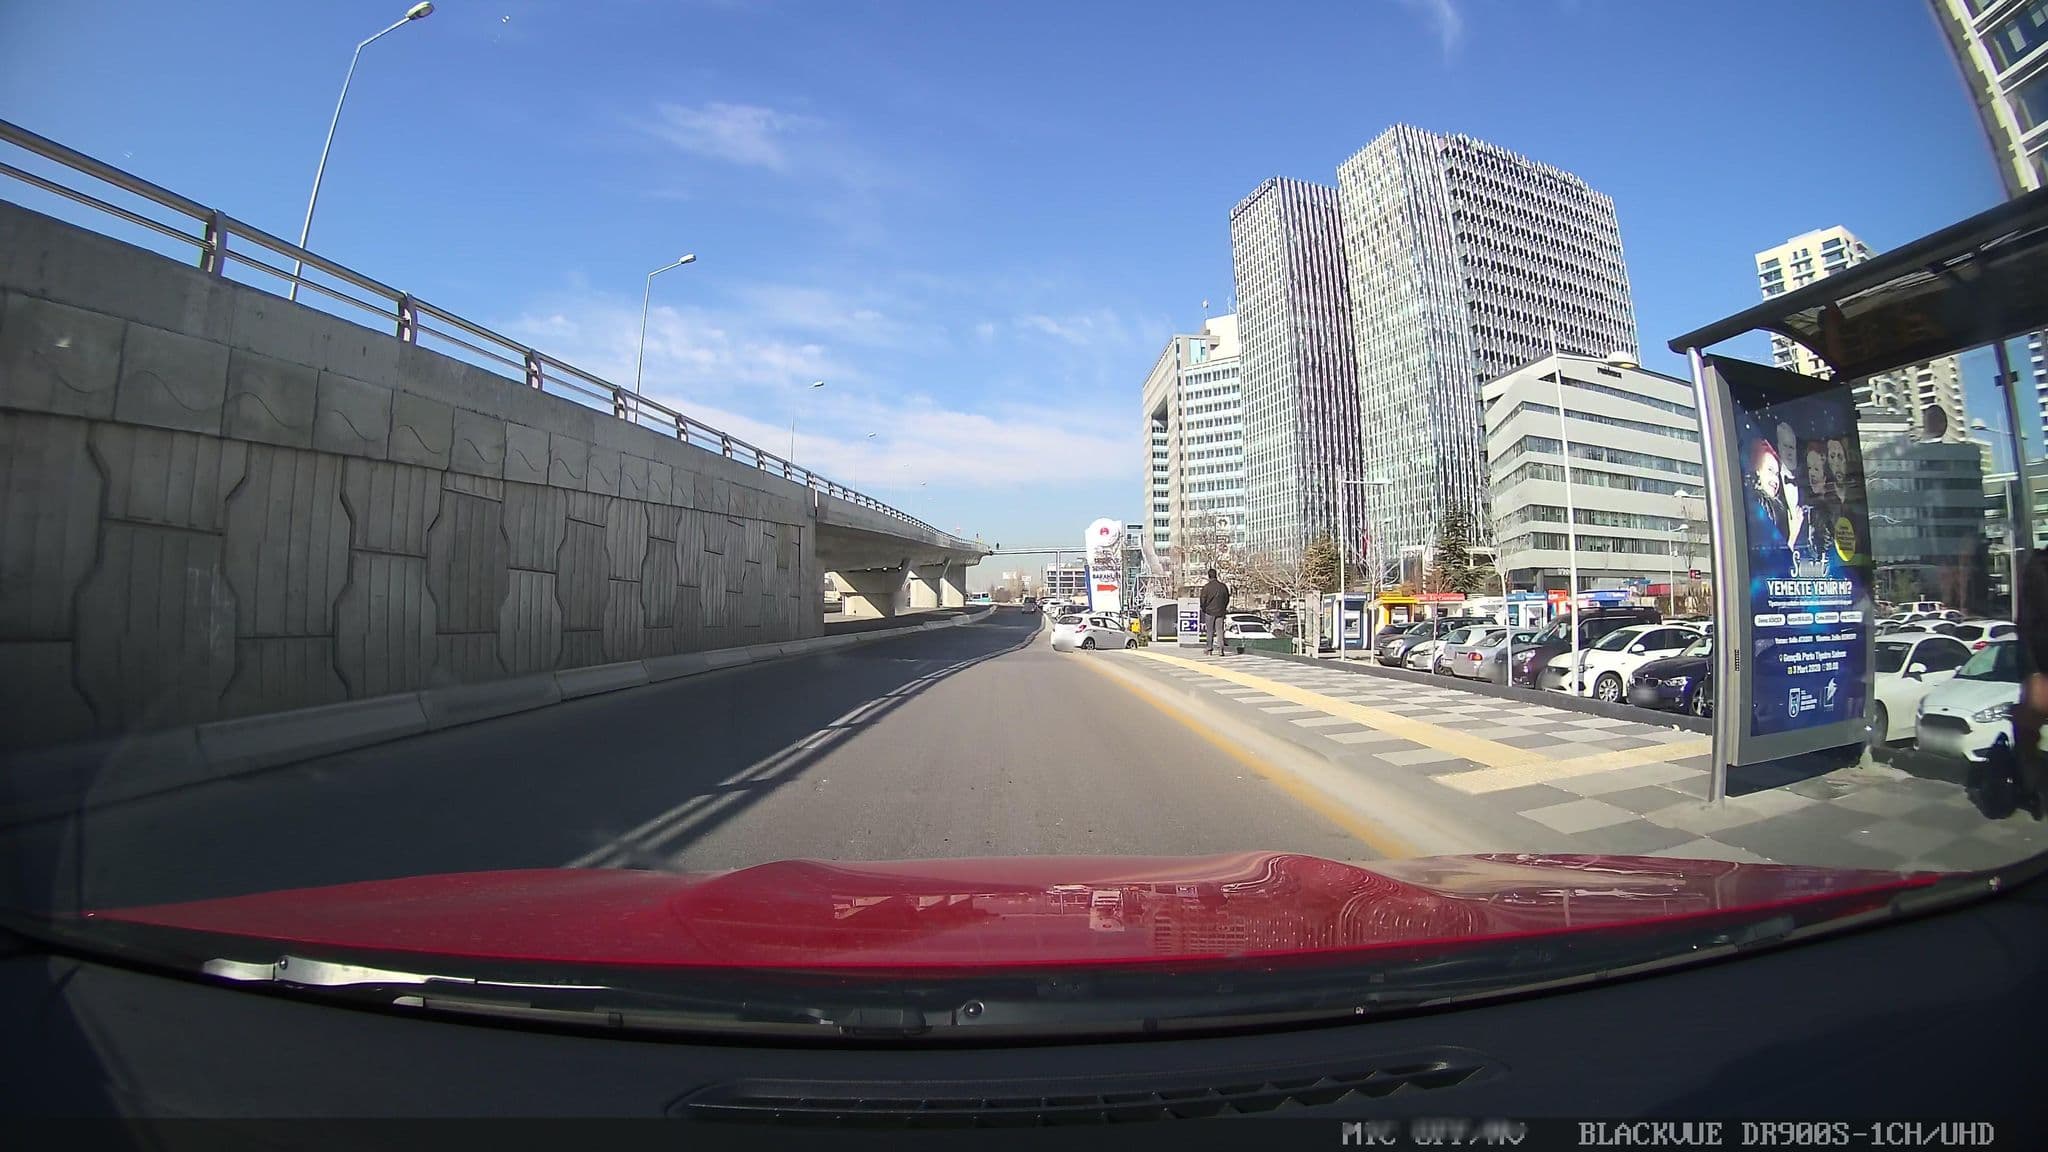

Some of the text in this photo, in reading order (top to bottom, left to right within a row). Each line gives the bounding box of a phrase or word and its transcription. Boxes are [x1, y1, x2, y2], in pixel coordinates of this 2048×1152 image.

[1767, 580, 1811, 596] YEMEKTE
[1813, 578, 1838, 595] YENİR
[1181, 620, 1190, 631] P
